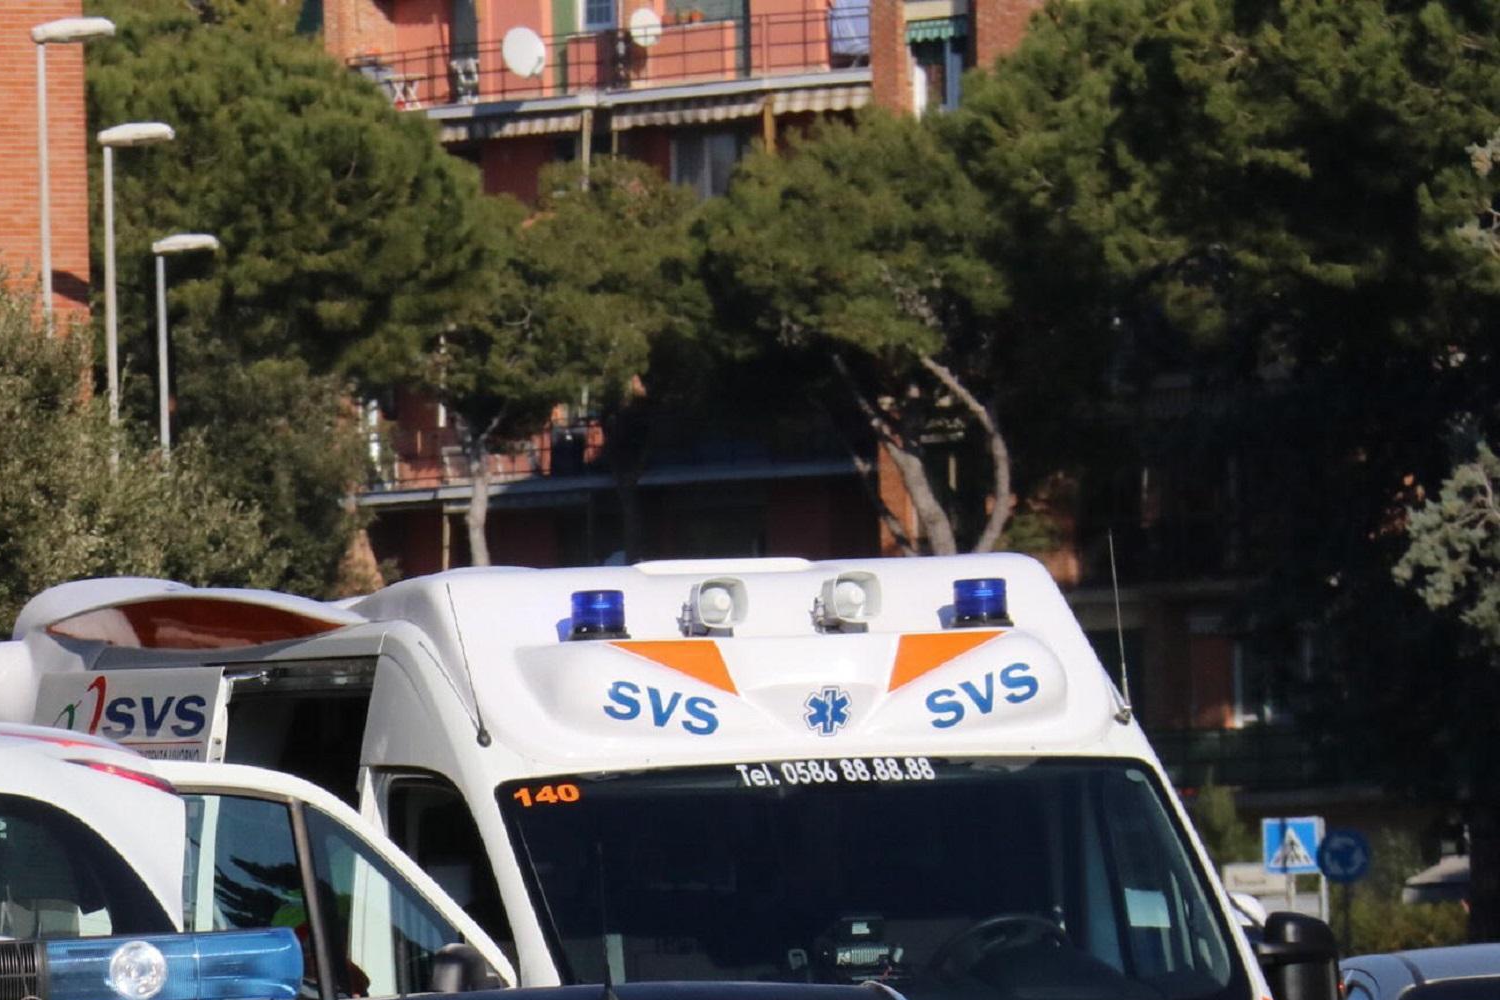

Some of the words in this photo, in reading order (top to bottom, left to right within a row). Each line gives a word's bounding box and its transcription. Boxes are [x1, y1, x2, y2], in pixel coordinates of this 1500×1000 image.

[102, 695, 206, 738] SVS
[603, 680, 719, 735] SVS
[925, 662, 1039, 729] SVS
[736, 764, 780, 786] Tel.
[781, 760, 838, 784] 0586
[839, 757, 935, 782] 88.88.88
[513, 784, 580, 807] 140
